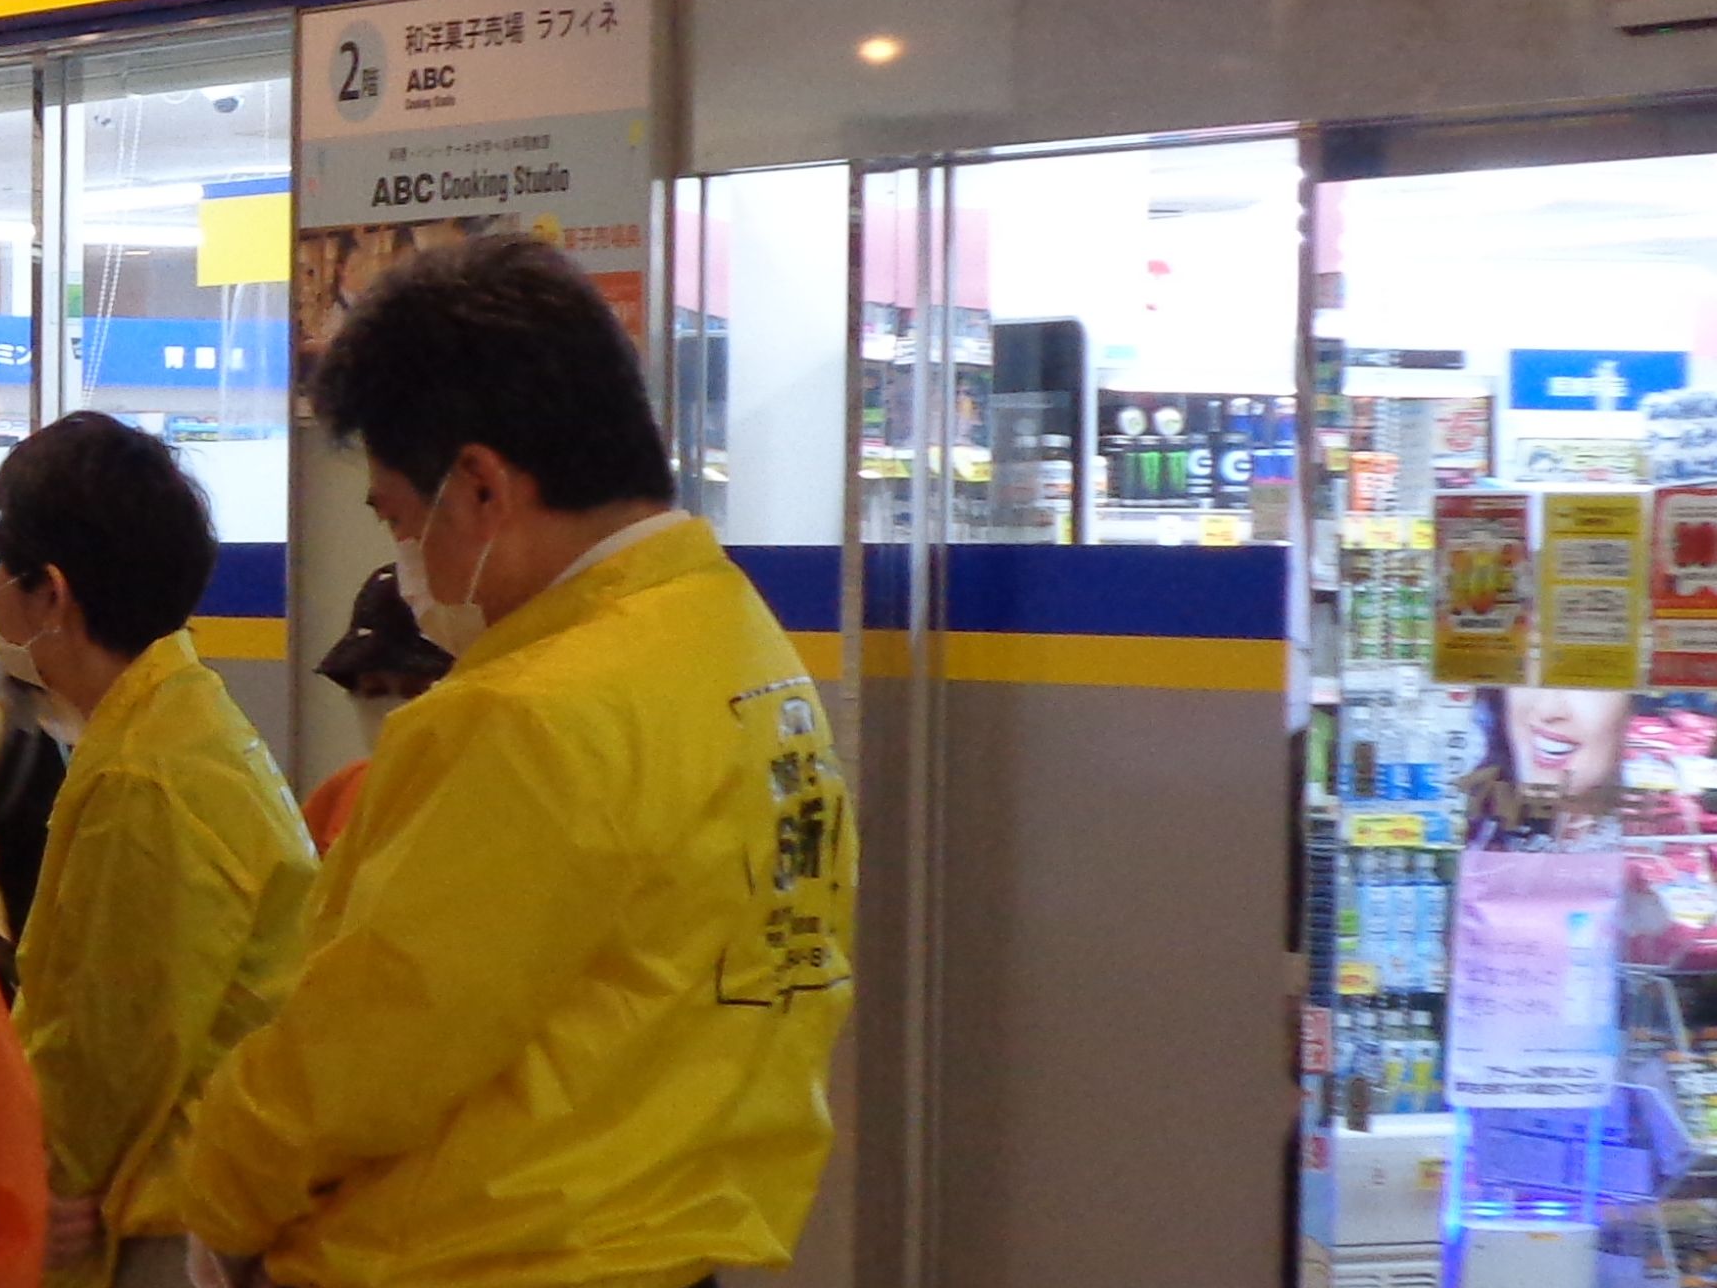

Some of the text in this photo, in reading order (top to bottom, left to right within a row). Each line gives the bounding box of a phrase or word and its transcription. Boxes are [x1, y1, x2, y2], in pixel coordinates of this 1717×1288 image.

[338, 2, 619, 101] 2階 和洋菓子売場 ラフィネ
[405, 65, 456, 92] ABC
[371, 162, 570, 207] ABC Cooking Studio
